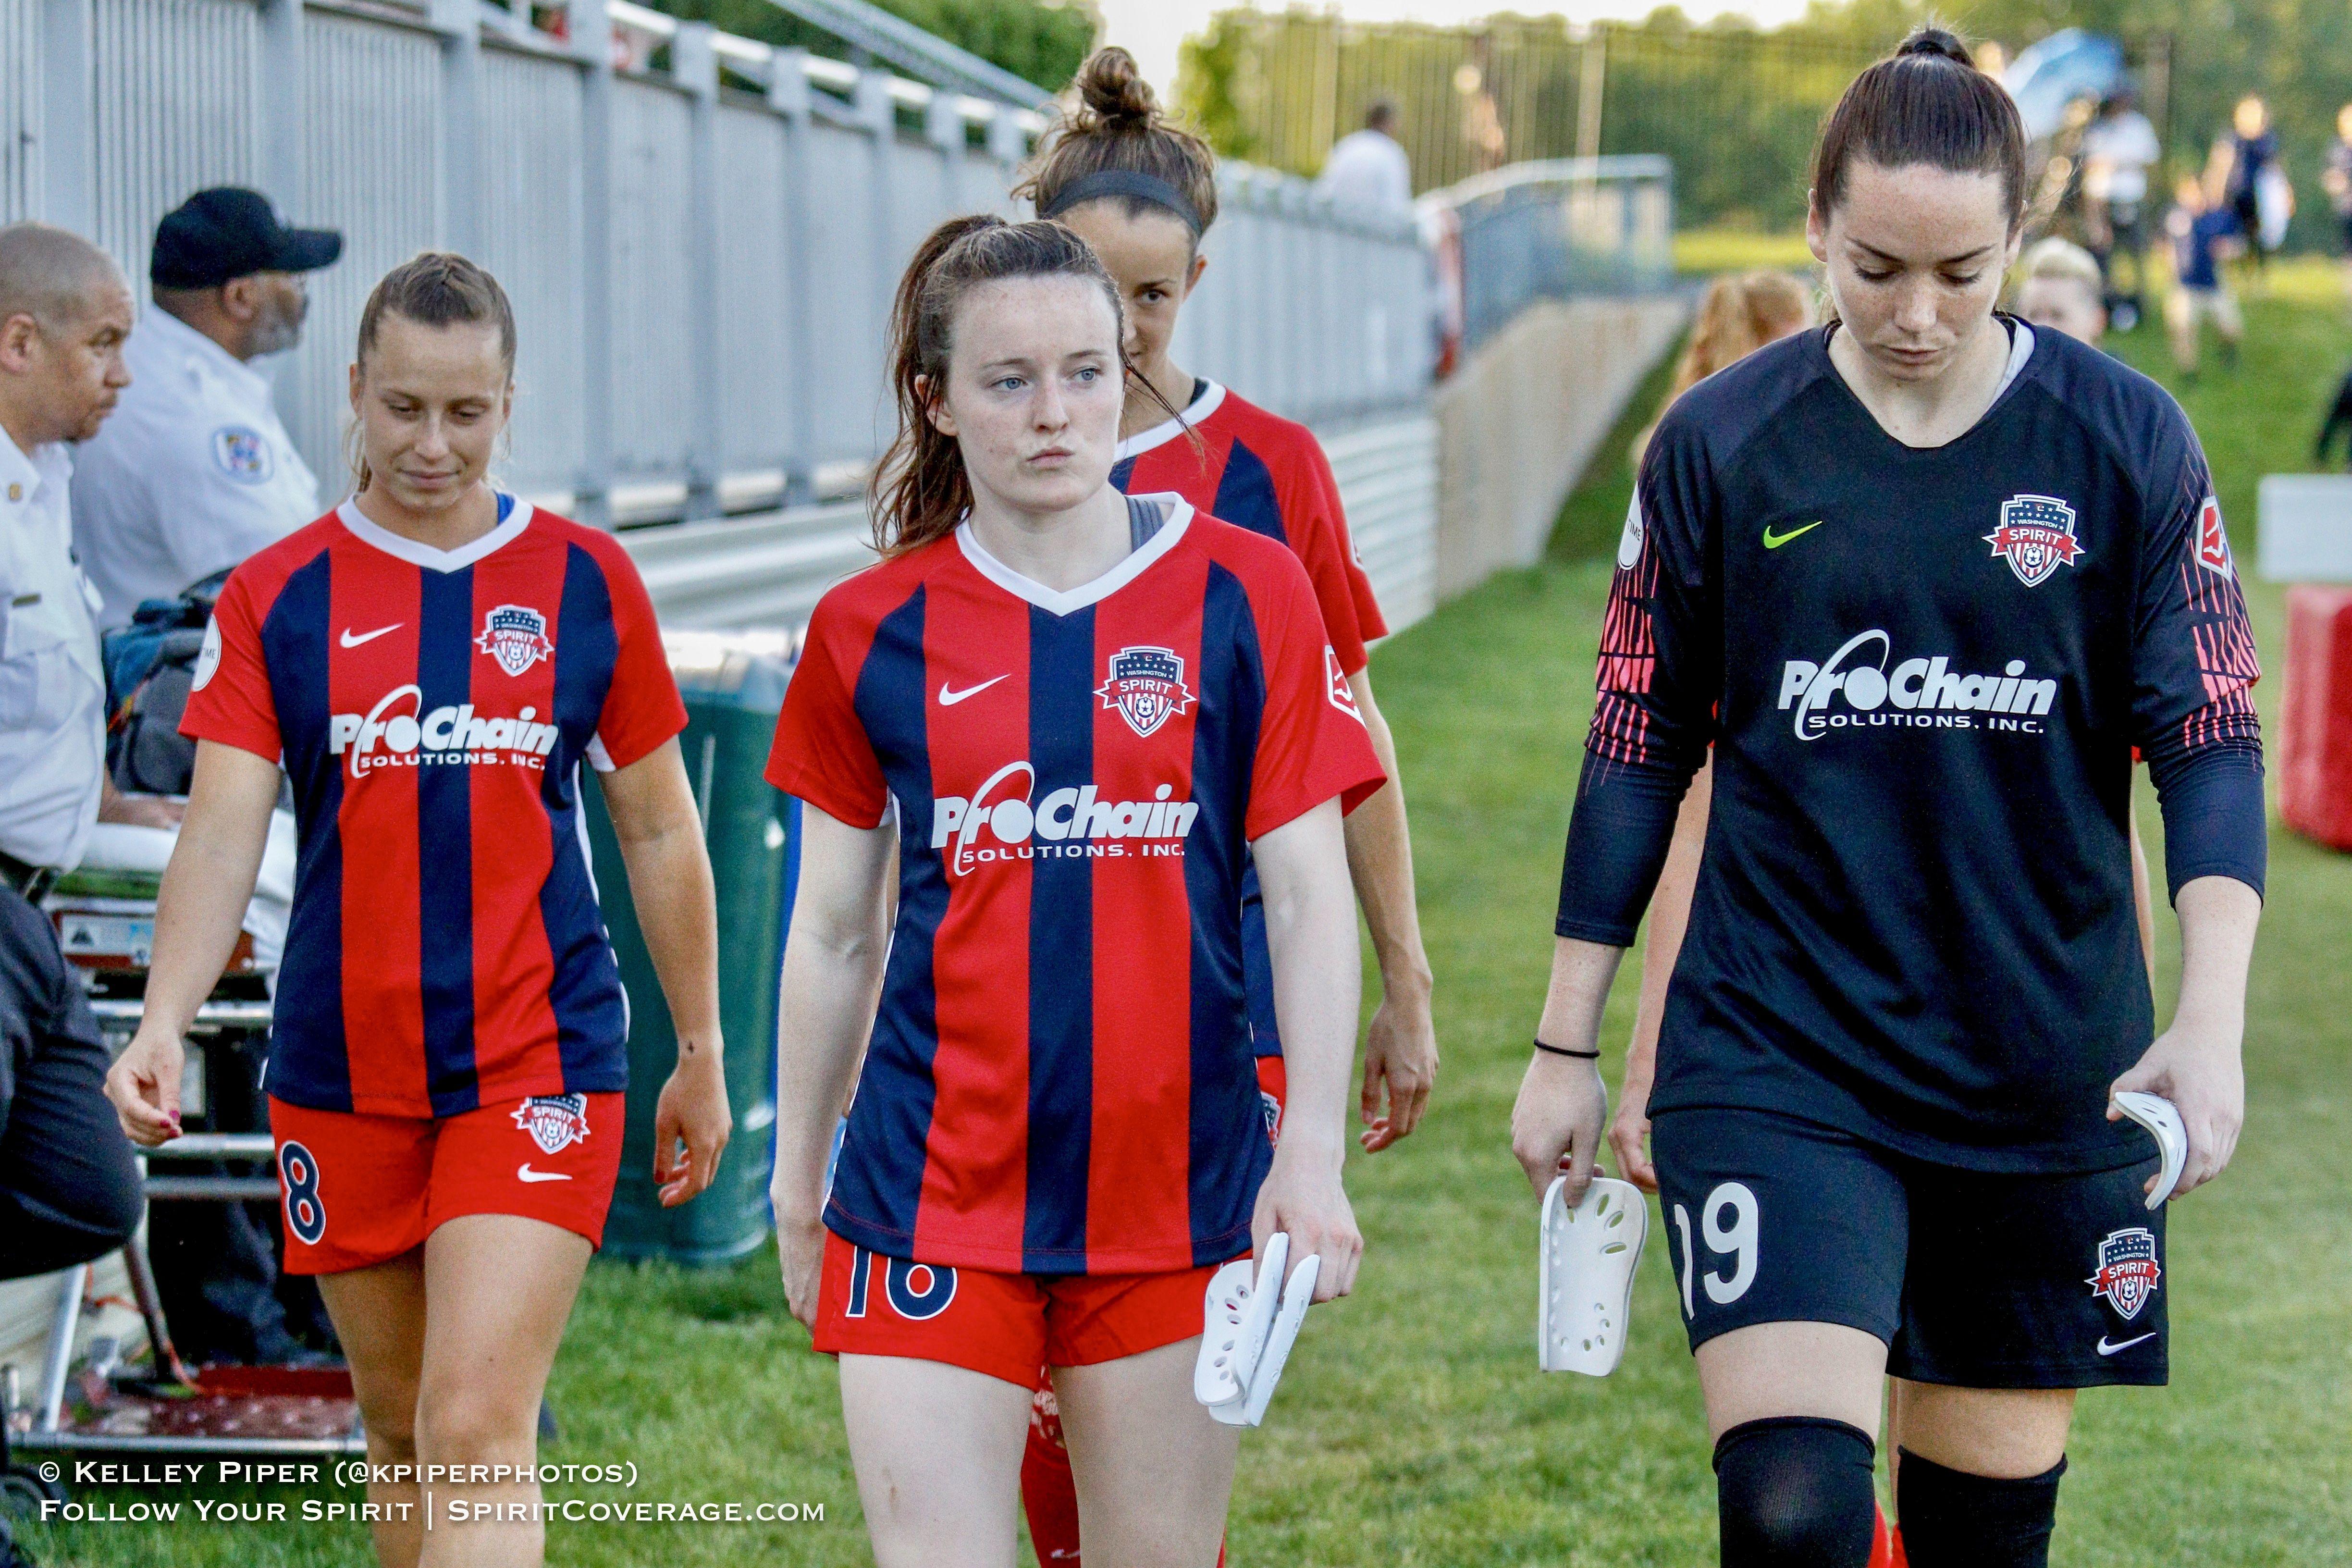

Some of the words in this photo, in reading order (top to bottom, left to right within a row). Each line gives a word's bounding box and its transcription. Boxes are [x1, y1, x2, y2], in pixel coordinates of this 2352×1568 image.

[2017, 519, 2058, 529] WASHINGTON
[2009, 528, 2063, 546] SPIRIT
[495, 630, 538, 644] SPIRIT
[1126, 669, 1167, 678] WASHINGTON
[1119, 679, 1173, 694] SPIRIT
[1778, 656, 2057, 715] ProChain
[330, 704, 559, 755] ProChain
[1989, 717, 2044, 733] INC.
[511, 753, 545, 771] INC.
[931, 784, 1199, 849] ProChain
[1142, 843, 1185, 857] INC.
[533, 1106, 576, 1124] SPIRIT
[280, 1139, 326, 1245] 8
[1674, 1181, 1759, 1321] 19
[2113, 1252, 2145, 1262] WASHINGTON
[2108, 1262, 2150, 1279] SPIRIT
